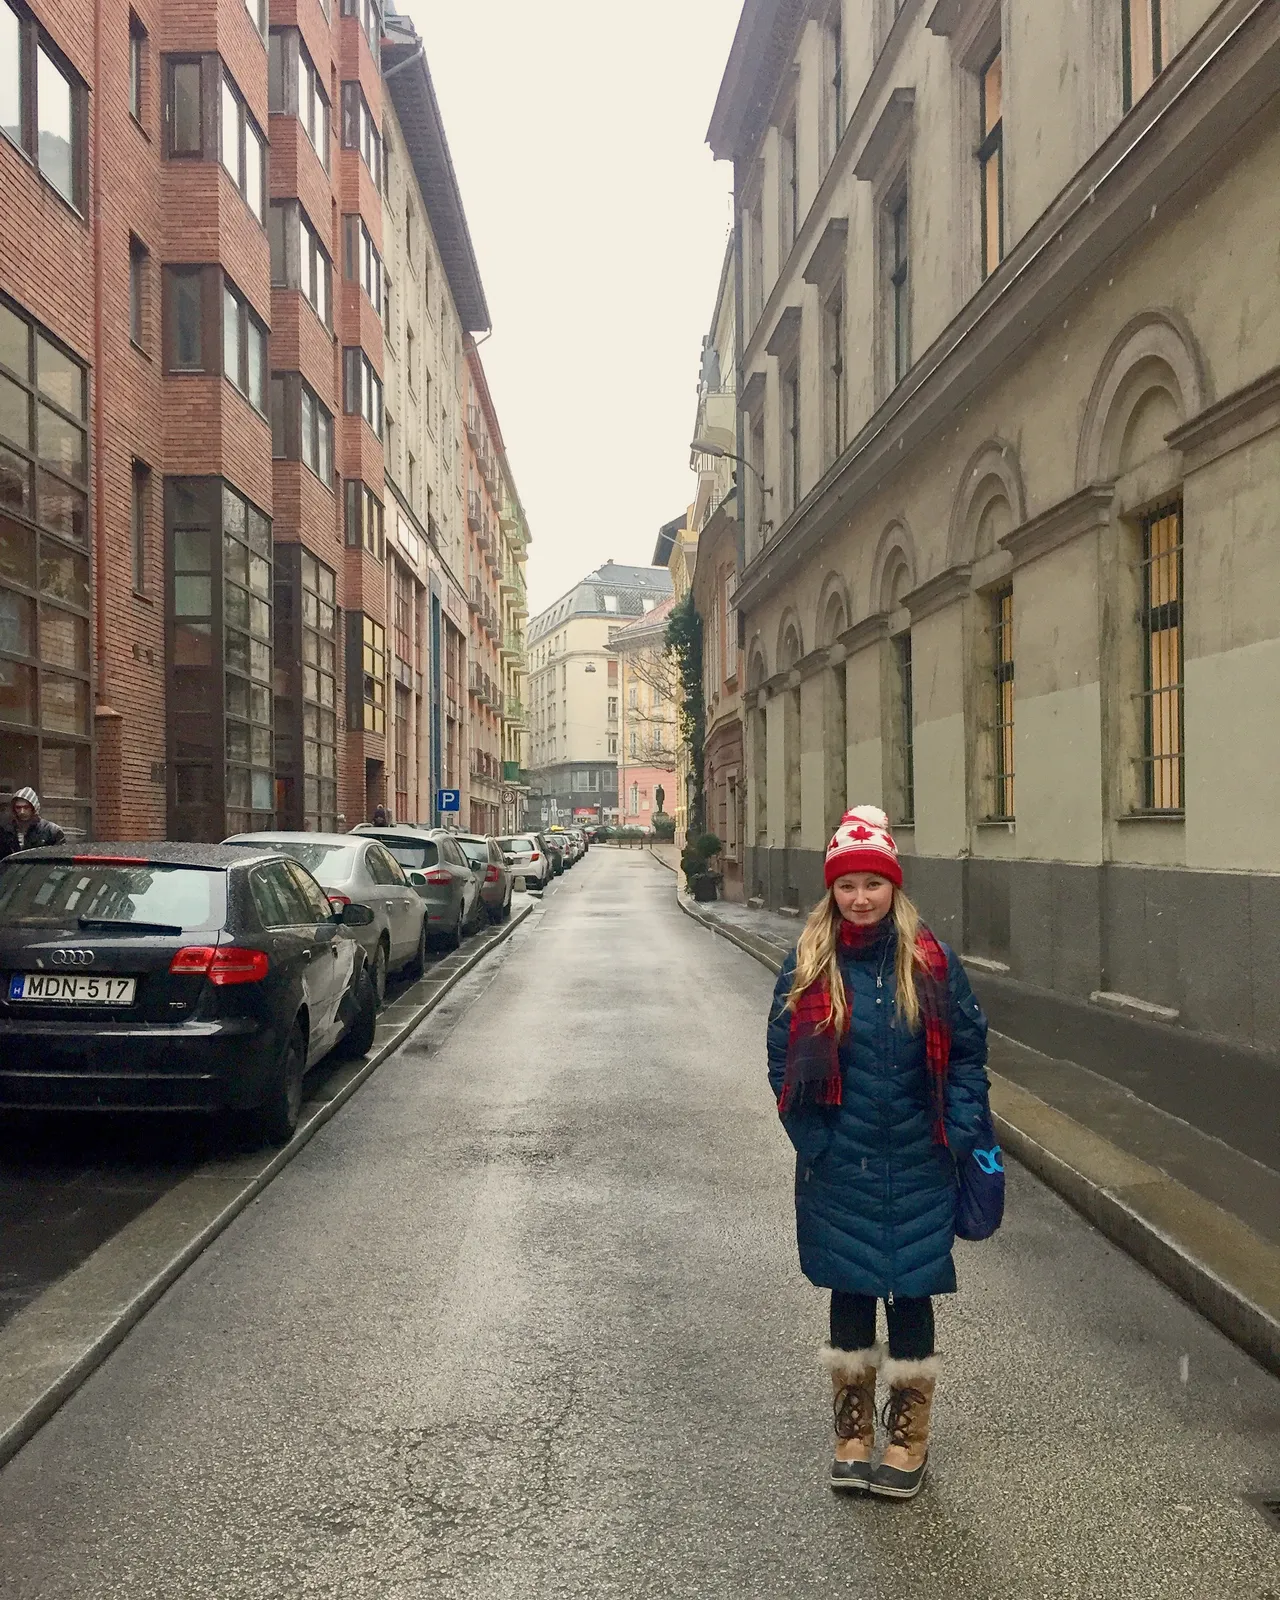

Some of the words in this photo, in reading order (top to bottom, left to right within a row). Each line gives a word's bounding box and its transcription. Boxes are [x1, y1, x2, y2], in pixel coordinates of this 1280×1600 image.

[442, 793, 455, 808] P
[13, 987, 20, 995] H
[28, 977, 129, 999] MDN-517
